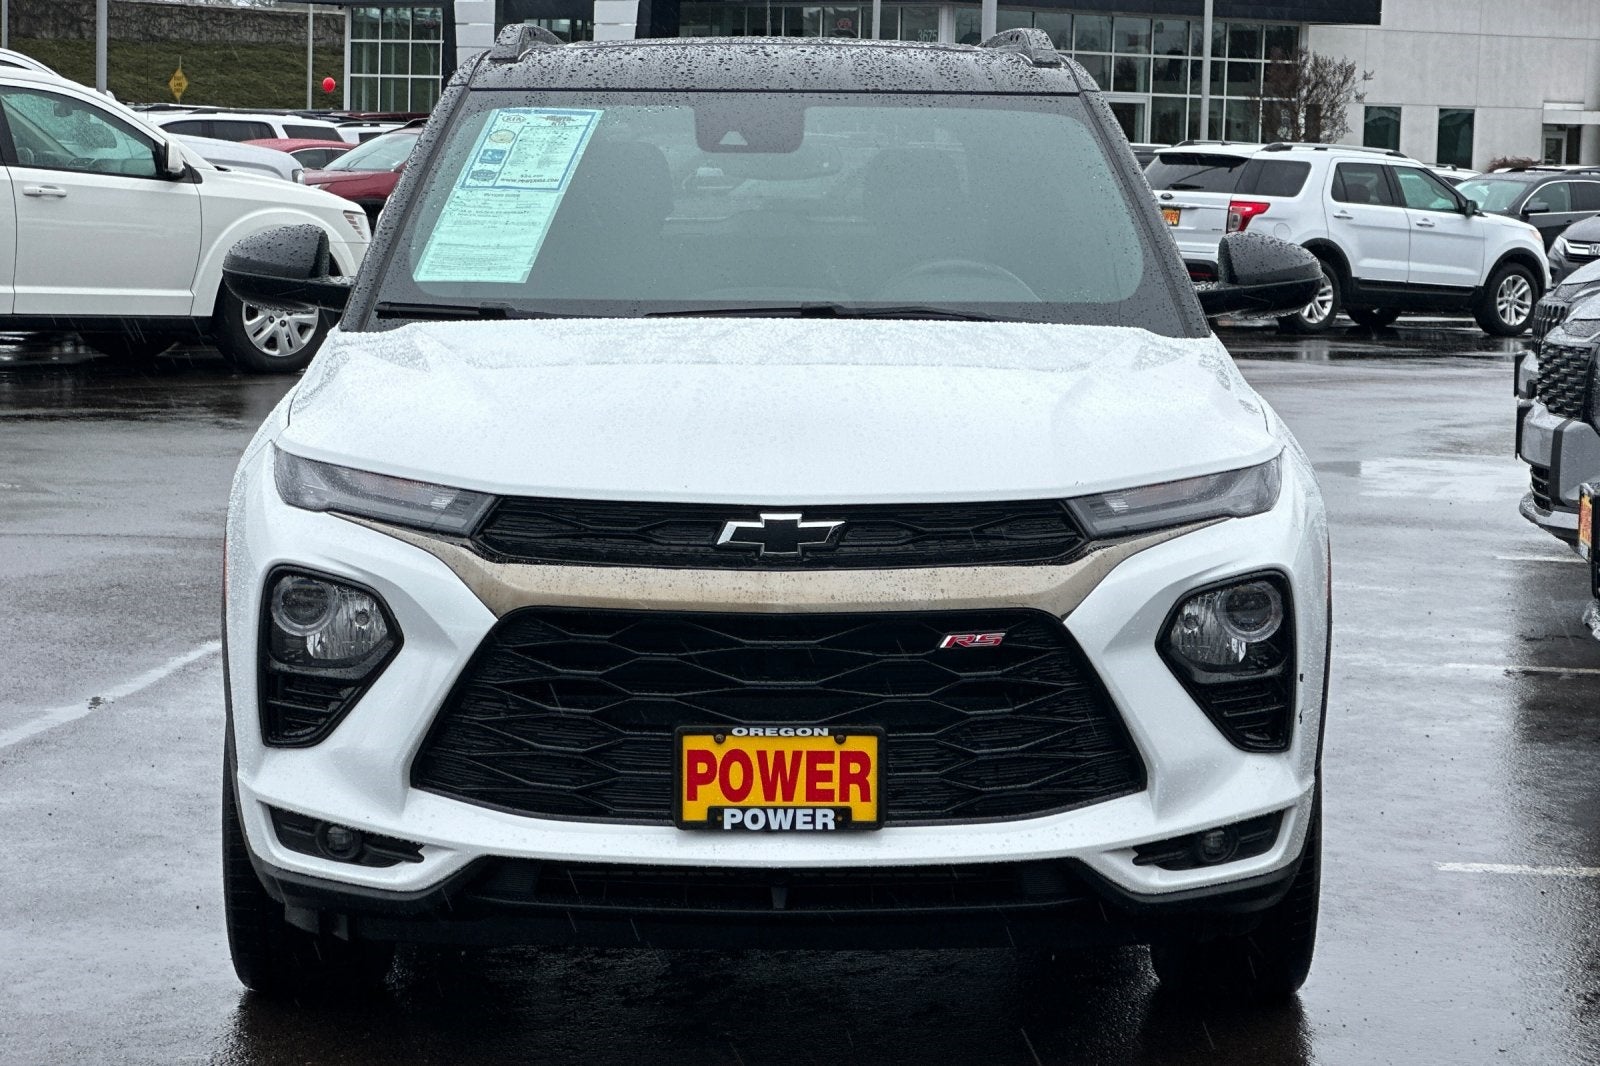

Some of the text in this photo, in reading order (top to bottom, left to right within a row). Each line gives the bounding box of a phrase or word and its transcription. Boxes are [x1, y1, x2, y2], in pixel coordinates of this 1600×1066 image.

[917, 29, 938, 42] 3675
[939, 632, 1006, 649] RS
[731, 727, 829, 737] OREGON
[686, 748, 872, 803] POWER
[723, 808, 836, 830] POWER
